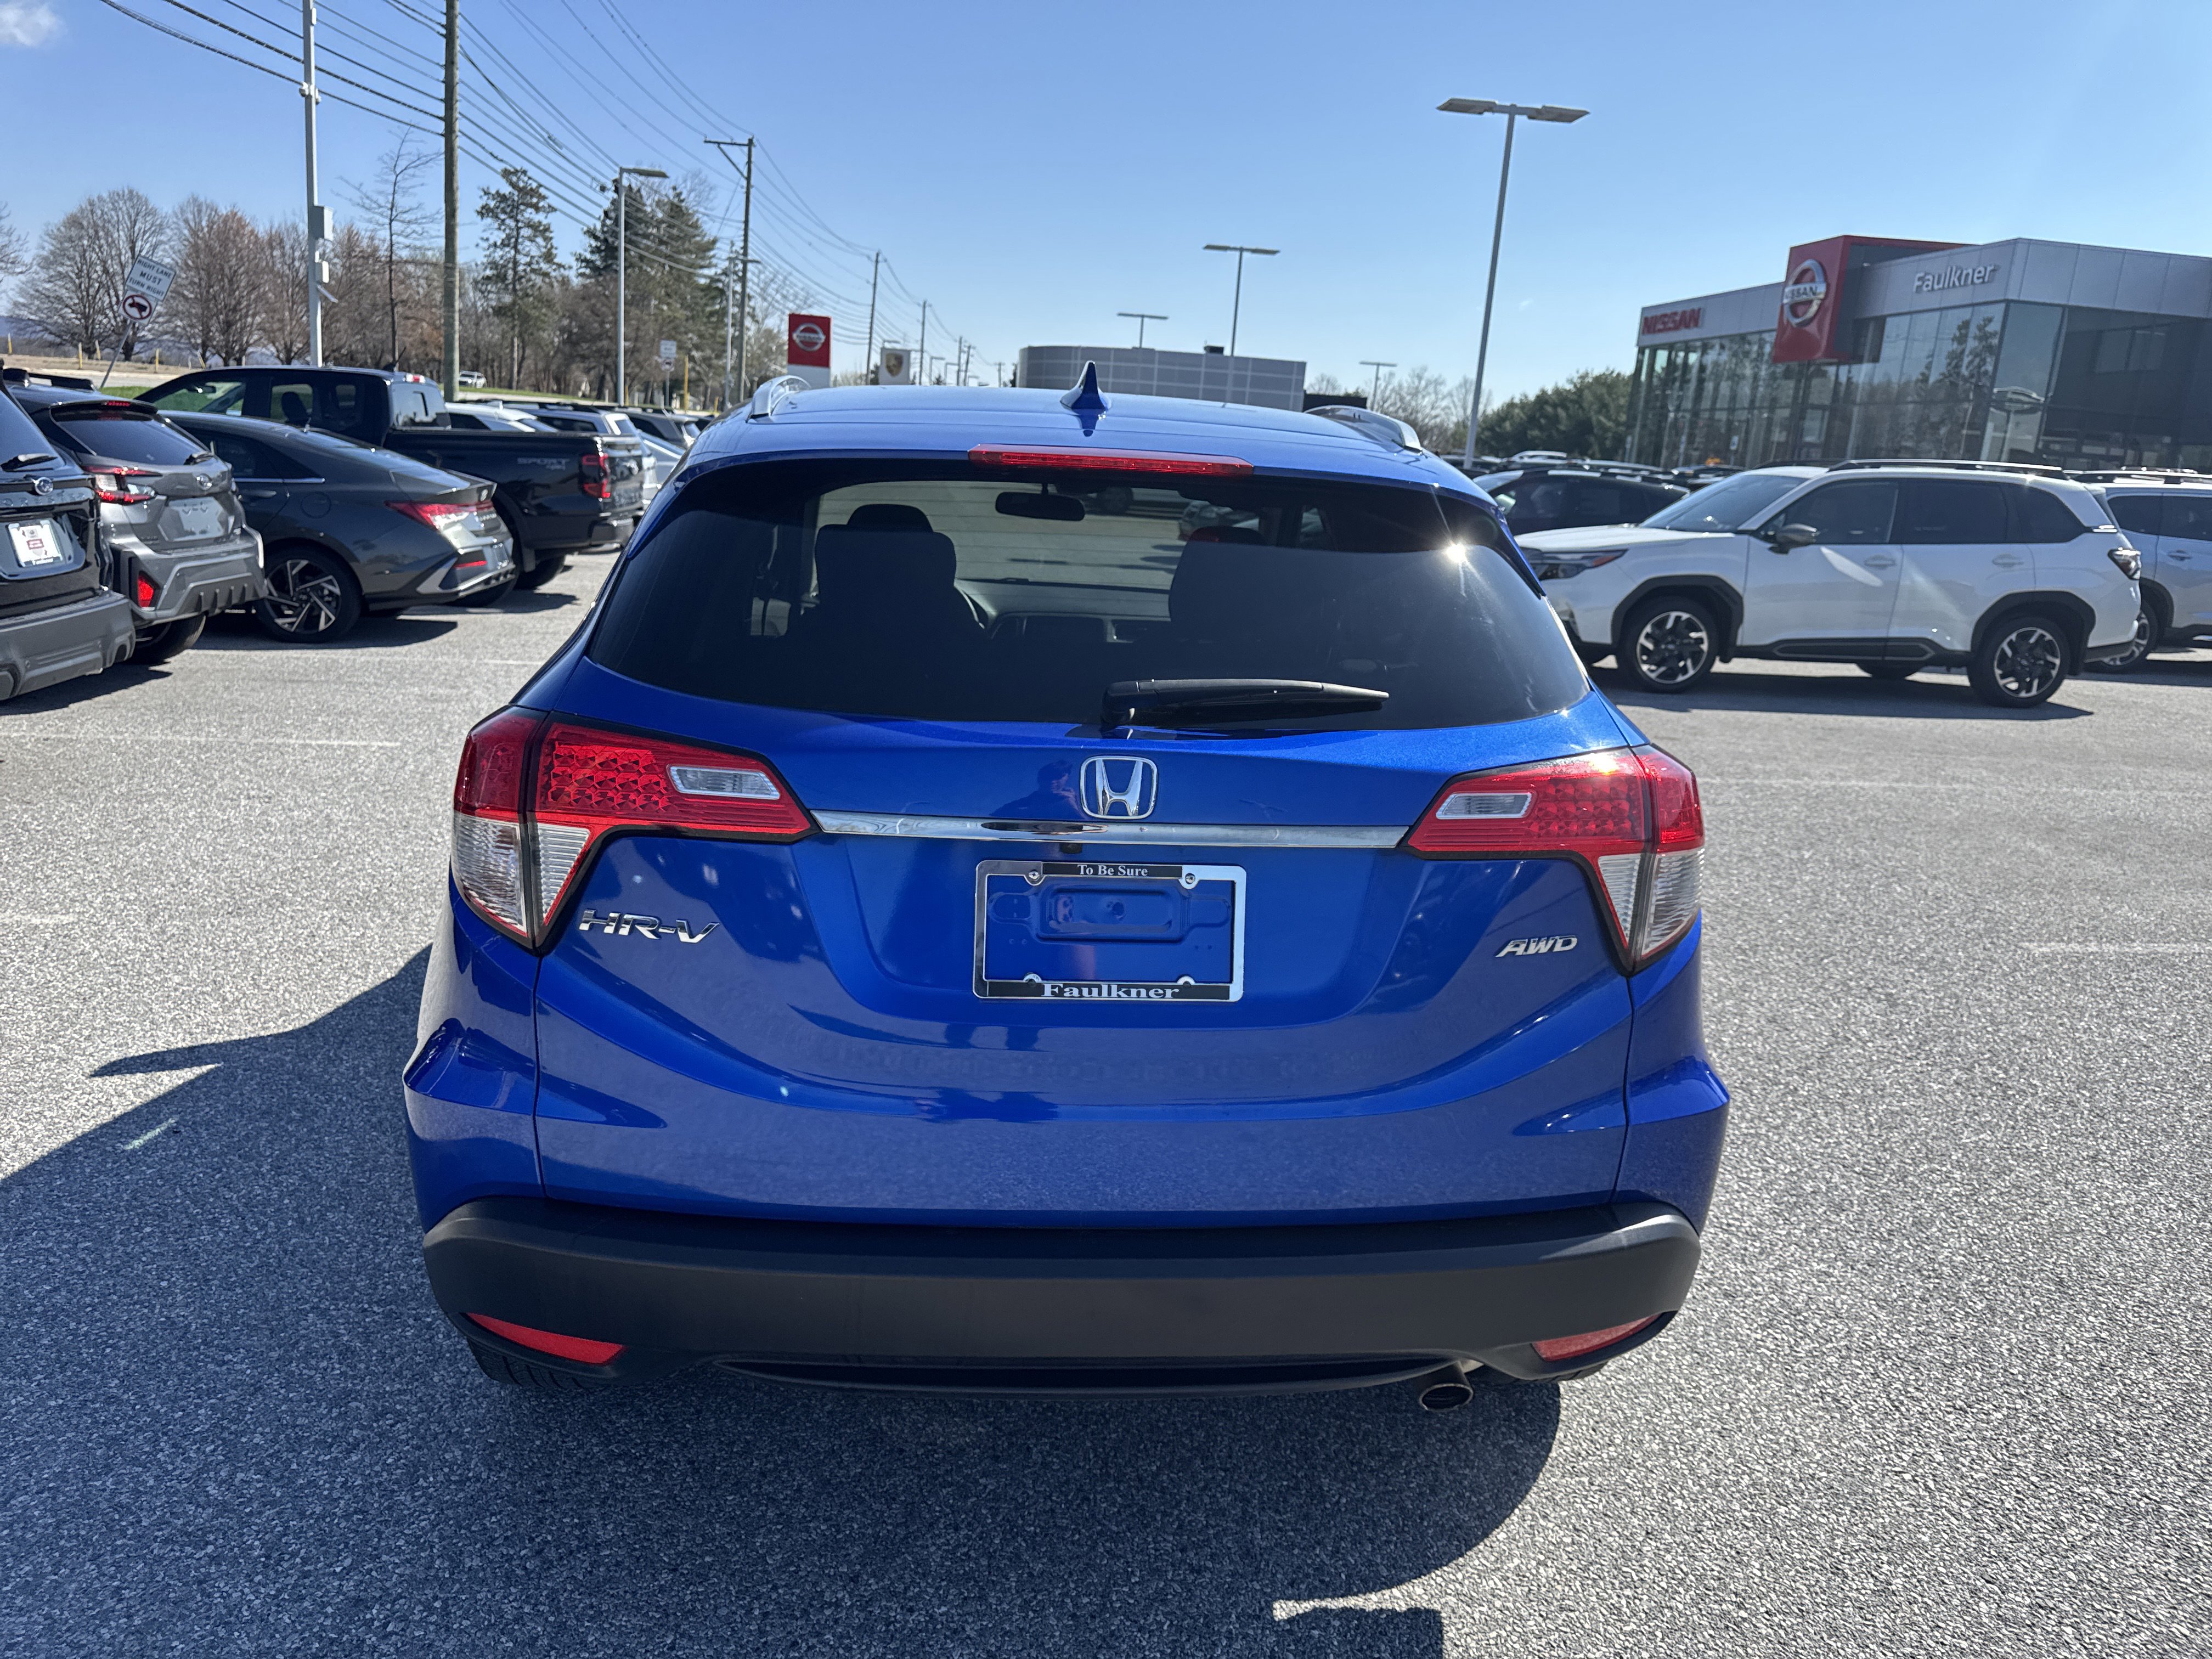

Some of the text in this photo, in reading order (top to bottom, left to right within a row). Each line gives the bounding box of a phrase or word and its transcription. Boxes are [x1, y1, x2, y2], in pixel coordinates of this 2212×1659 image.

[138, 259, 172, 278] RIGHT LANE
[140, 271, 162, 285] MUST
[129, 277, 164, 296] TURN RIGHT
[1913, 265, 1995, 292] Faulkner
[1641, 308, 1701, 334] NISSAN
[1077, 864, 1148, 876] To Be Sure
[579, 909, 720, 943] HR-V
[1495, 935, 1578, 957] AWD
[1041, 983, 1180, 998] Faulkner
